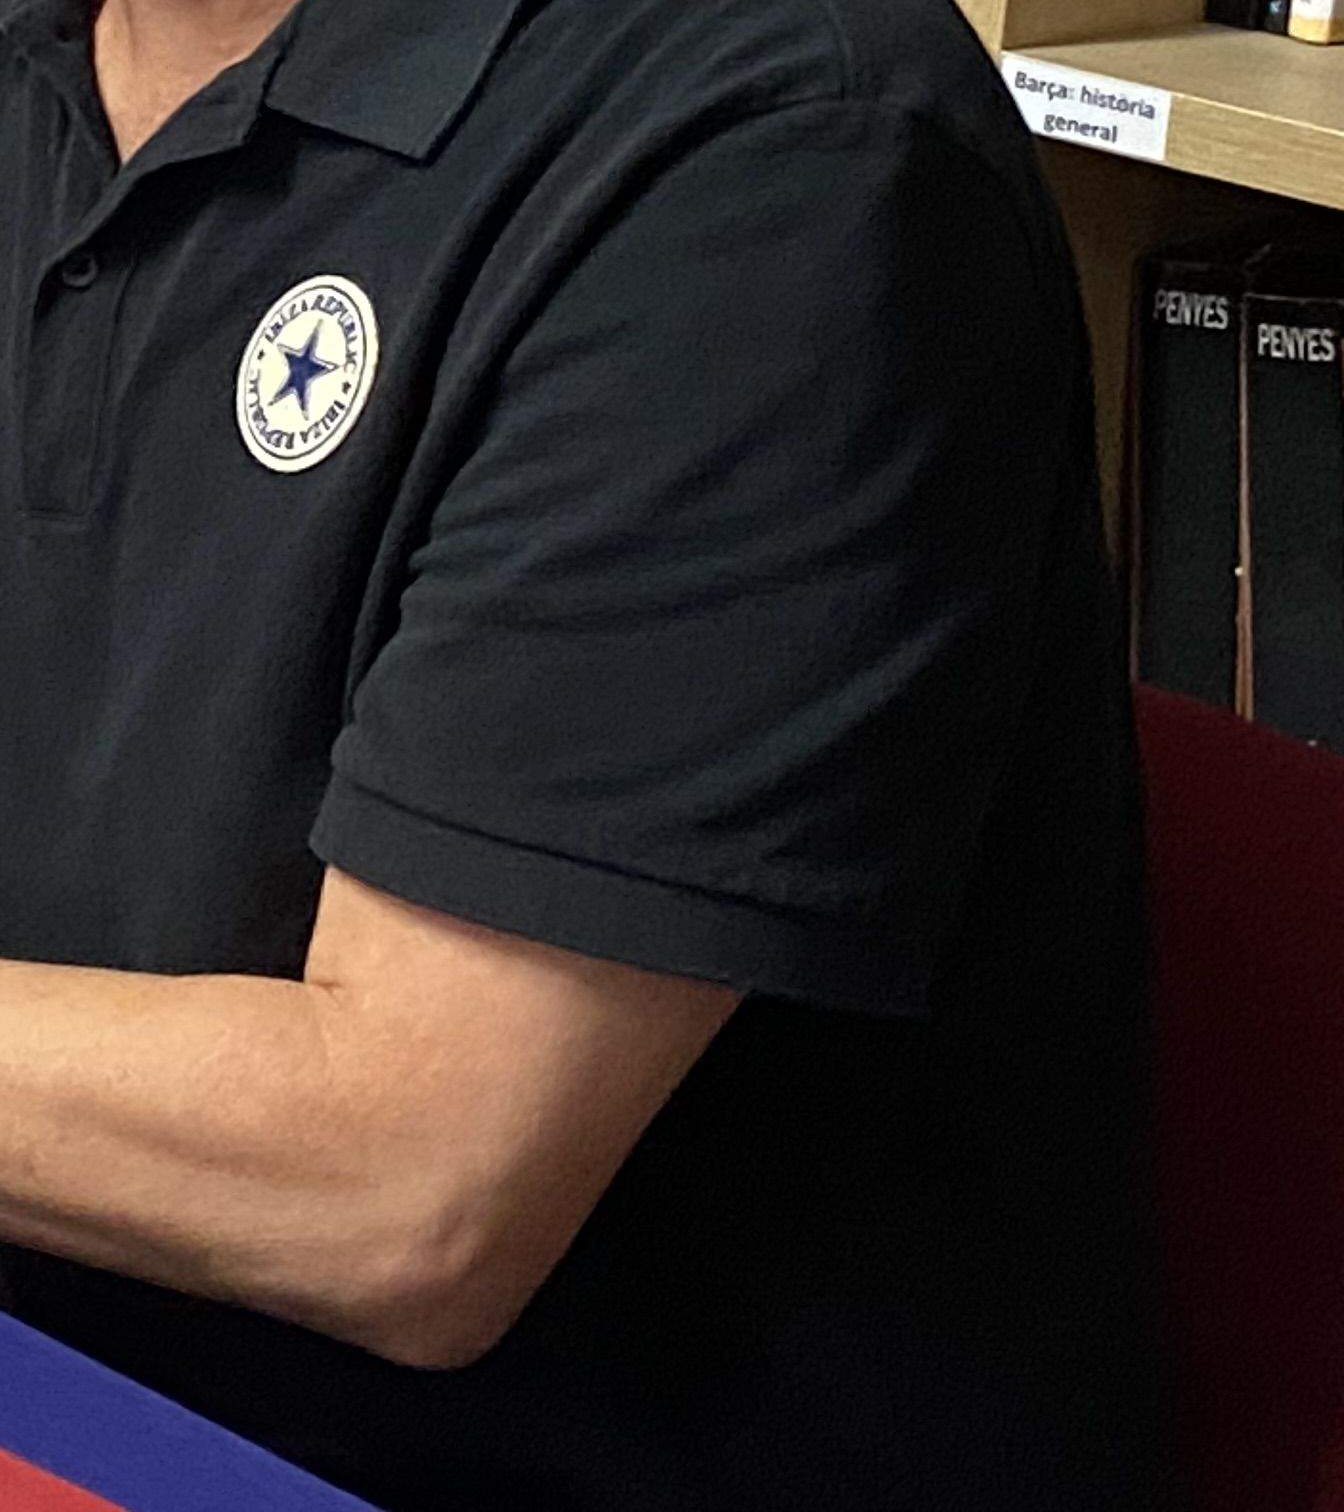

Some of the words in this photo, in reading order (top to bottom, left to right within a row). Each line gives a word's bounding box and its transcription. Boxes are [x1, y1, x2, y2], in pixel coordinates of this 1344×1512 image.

[1015, 71, 1075, 101] Barça:
[1043, 114, 1118, 143] general
[1153, 288, 1229, 330] PENYES
[311, 293, 359, 374] REPUBLIC
[1257, 322, 1336, 363] PENYES
